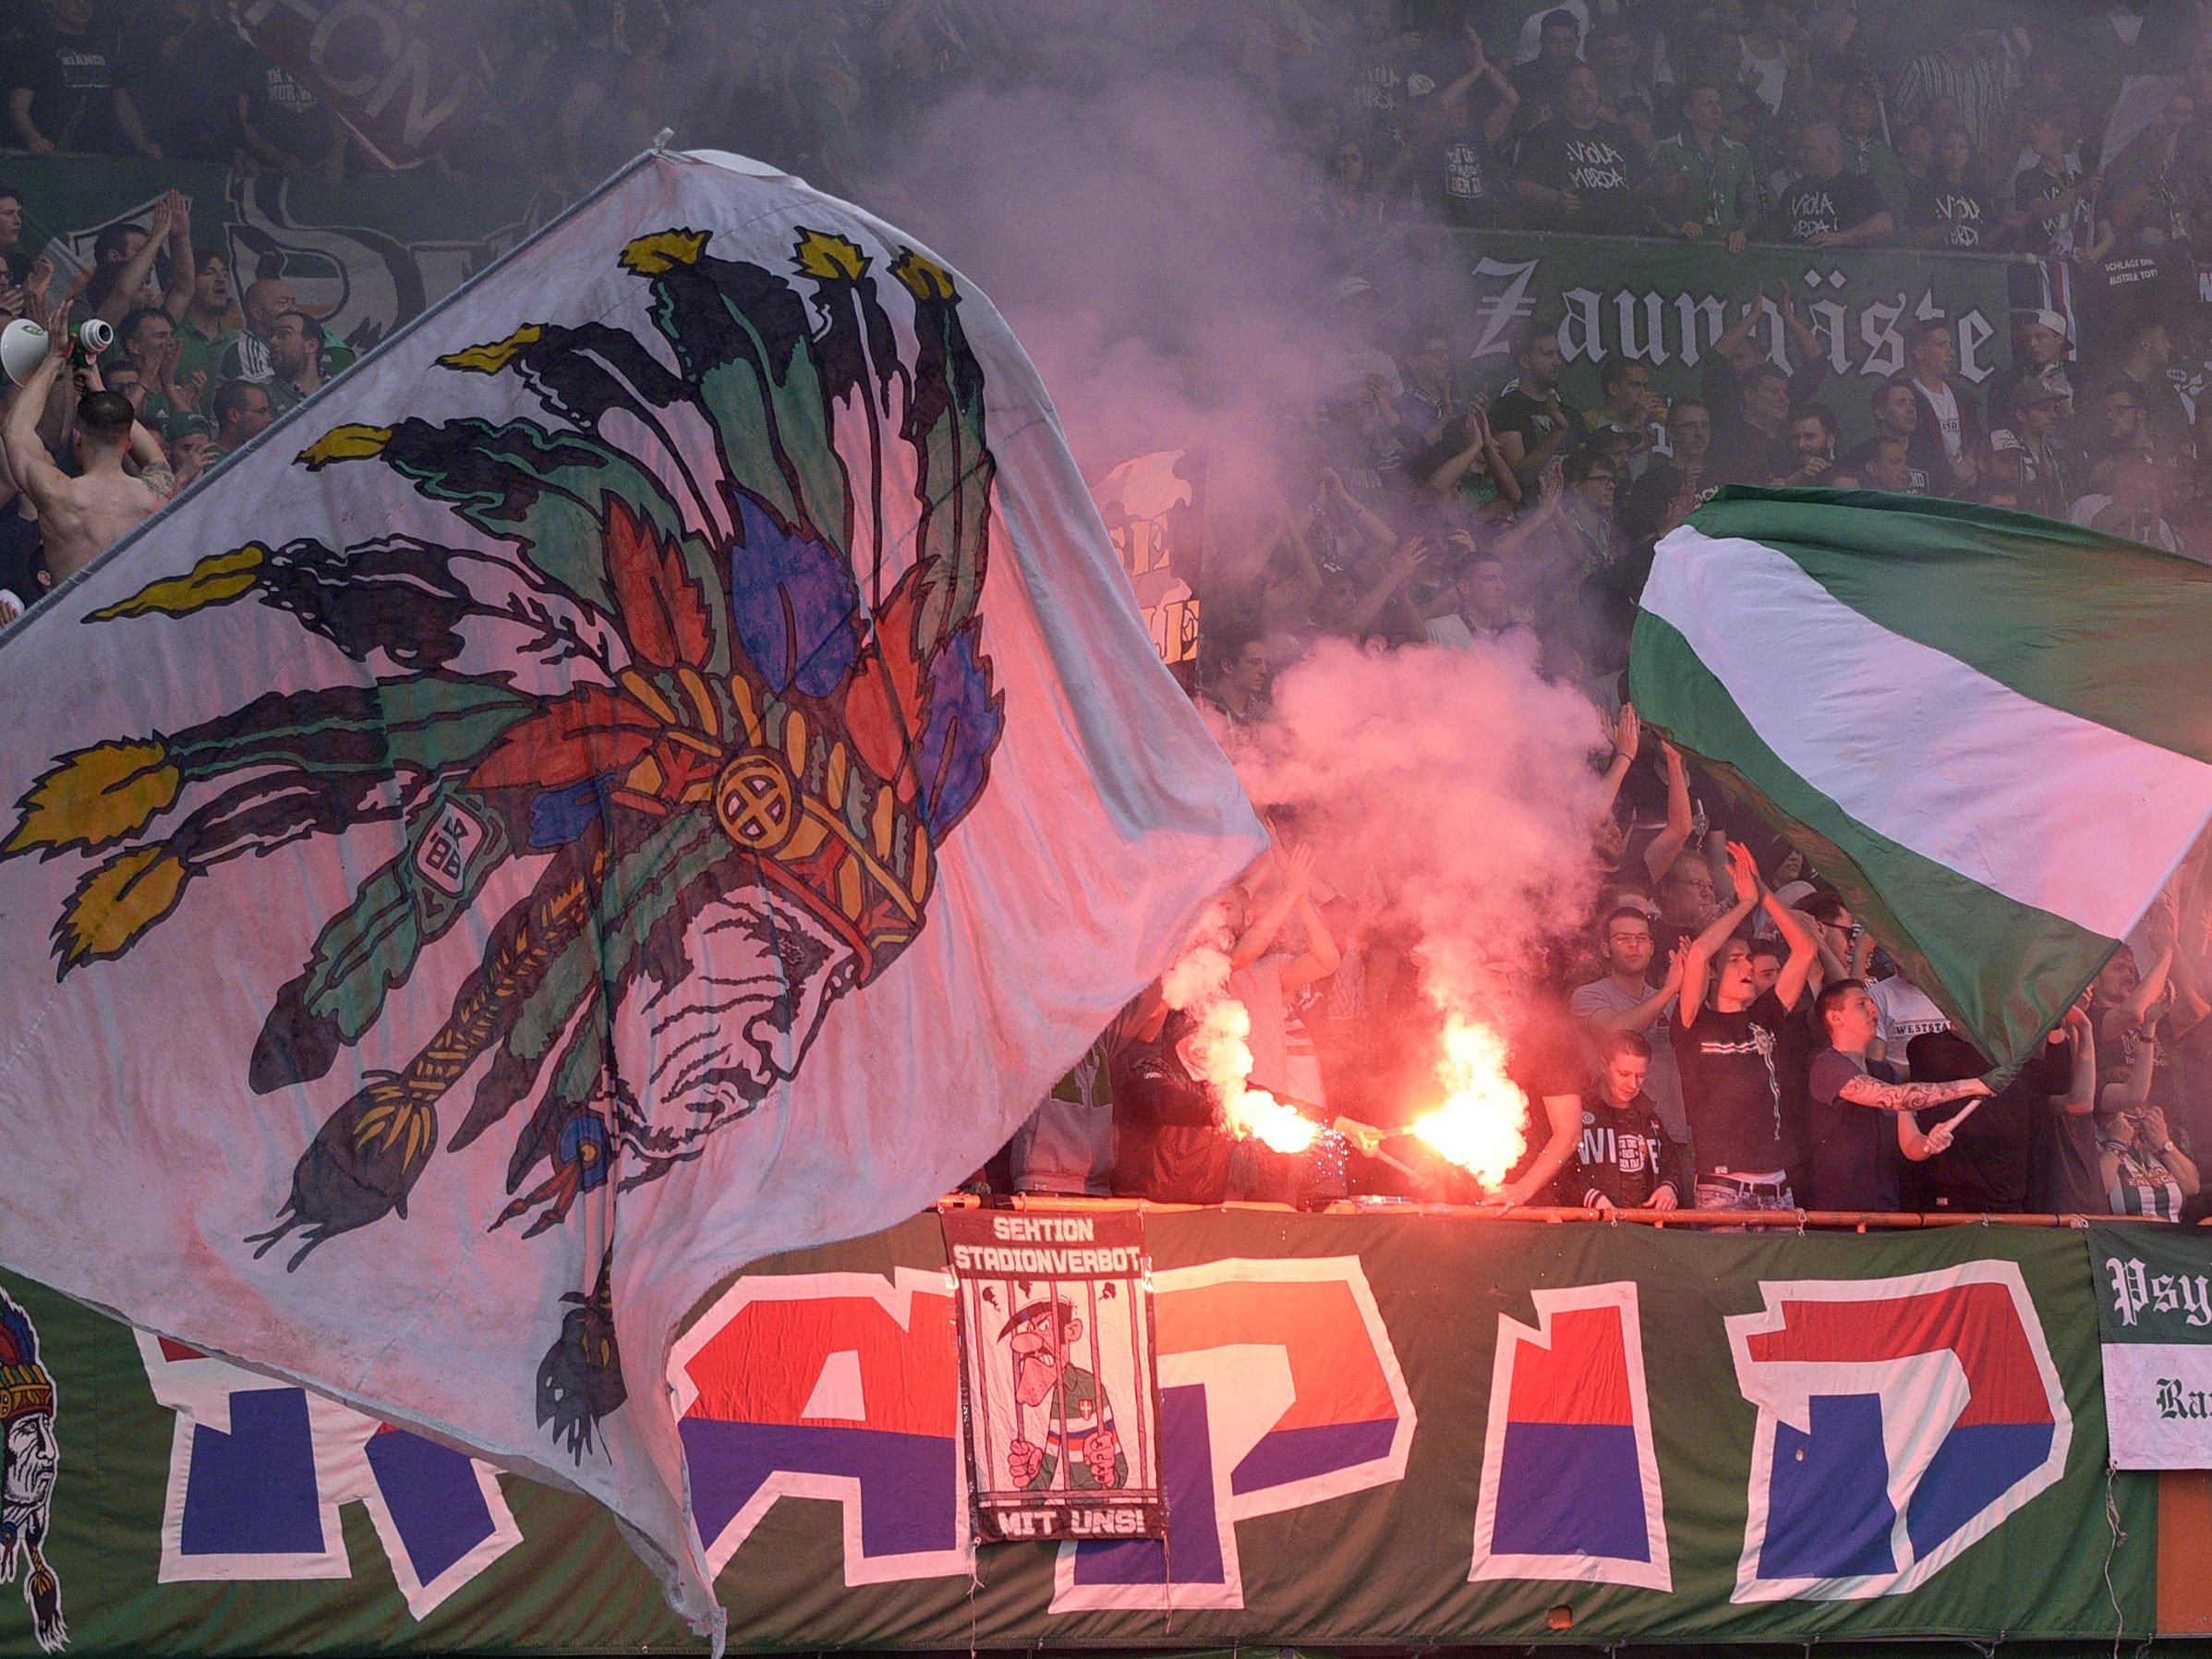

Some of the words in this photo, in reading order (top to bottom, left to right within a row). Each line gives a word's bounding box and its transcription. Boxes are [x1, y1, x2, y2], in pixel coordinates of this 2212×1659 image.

[2109, 272, 2140, 286] AUSTRIA
[953, 1245, 1141, 1274] STADIONVERBOT
[2105, 1257, 2212, 1326] Psy
[2156, 1377, 2212, 1420] Ra
[997, 1510, 1058, 1535] MIT
[1071, 1508, 1146, 1535] UNS!
